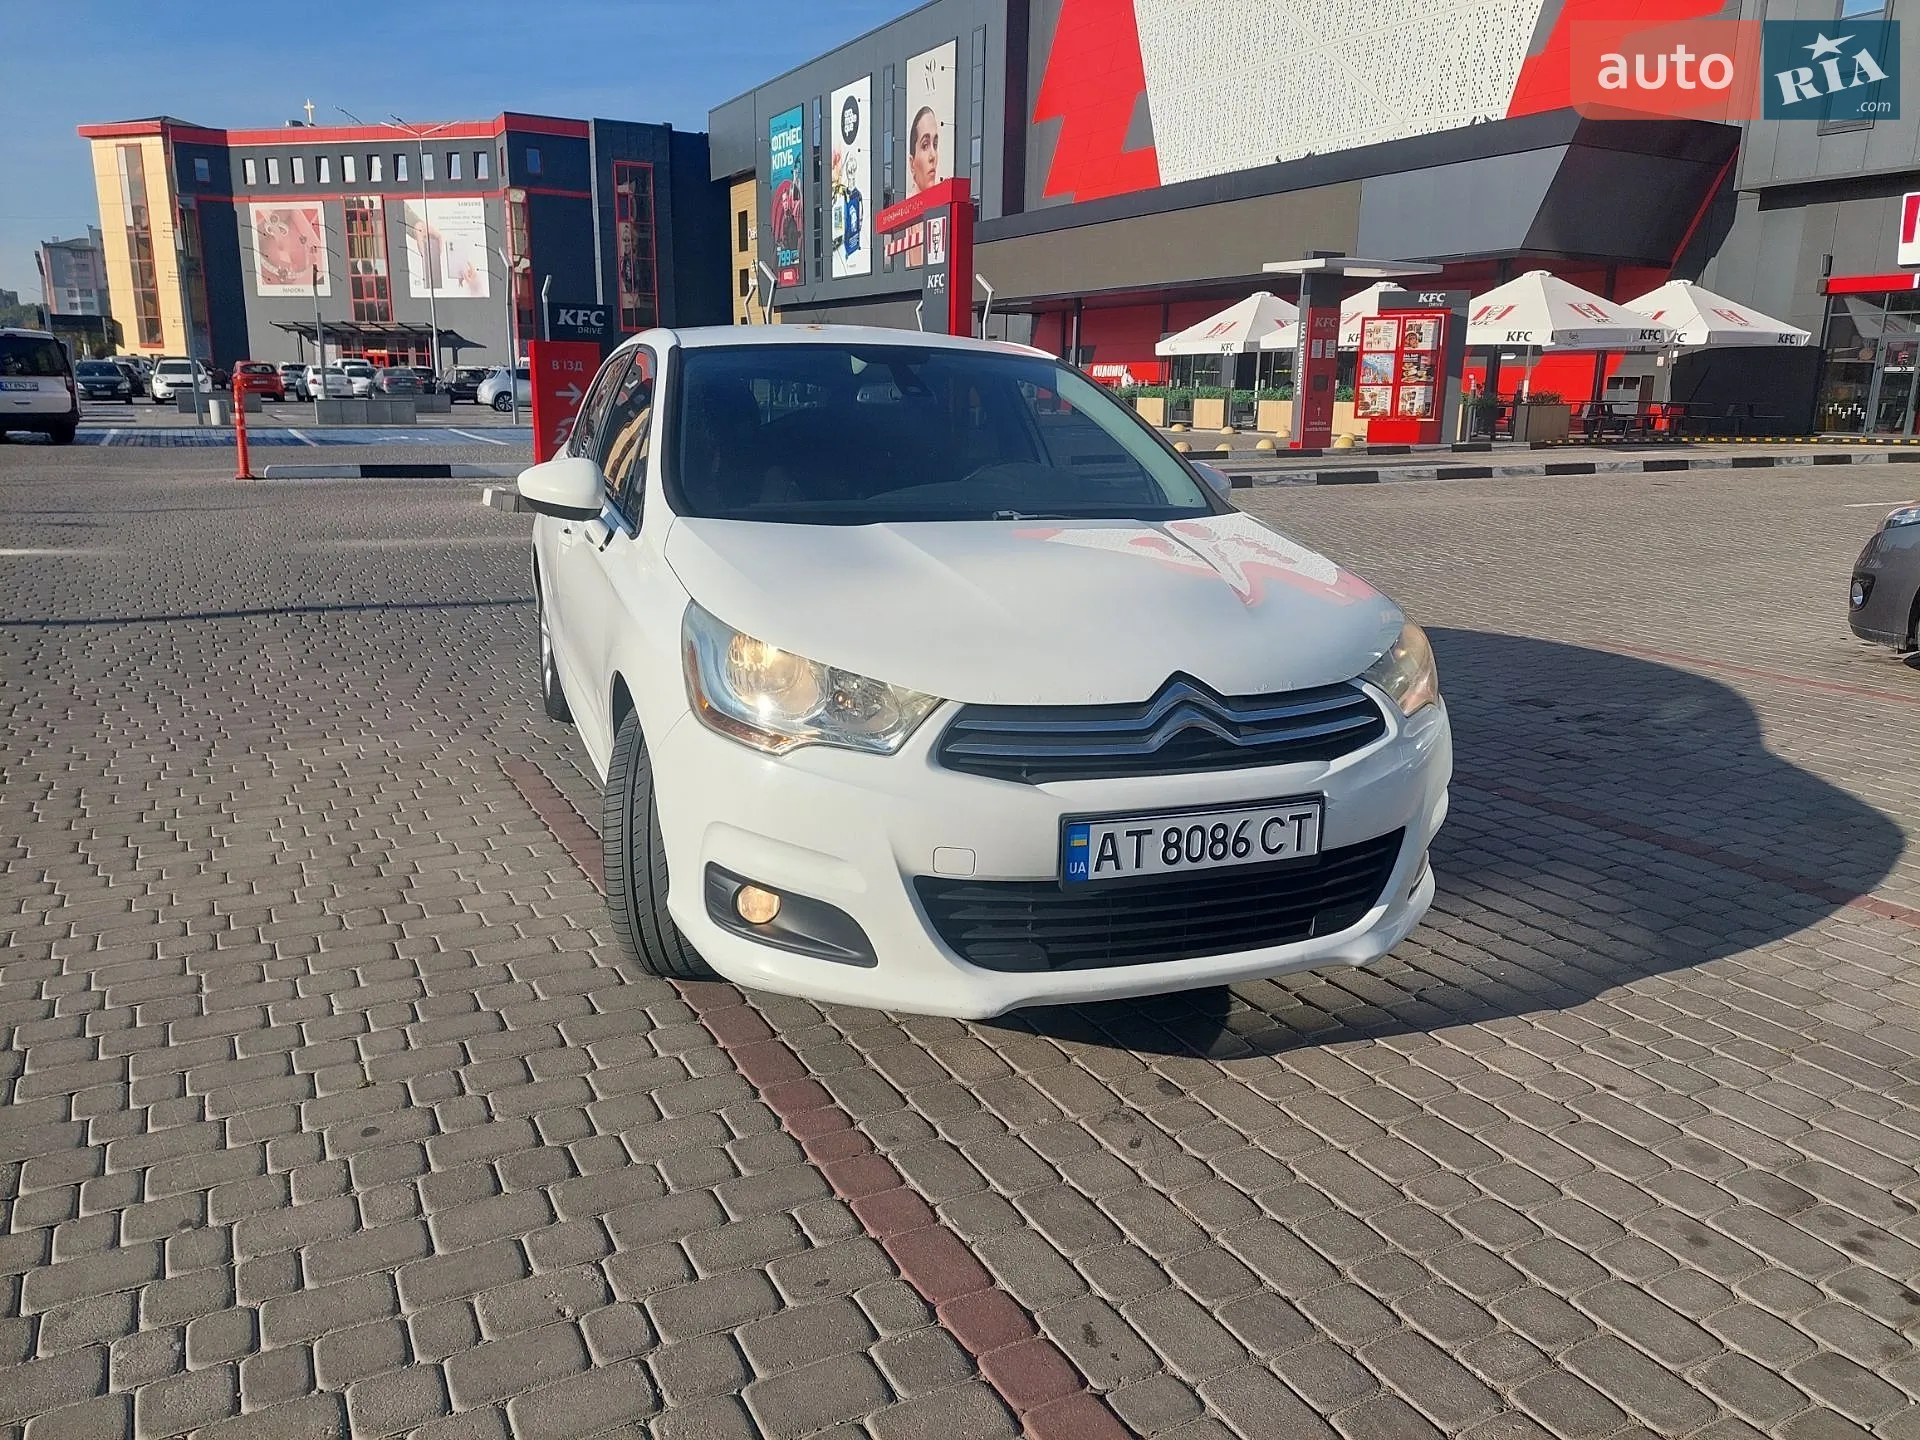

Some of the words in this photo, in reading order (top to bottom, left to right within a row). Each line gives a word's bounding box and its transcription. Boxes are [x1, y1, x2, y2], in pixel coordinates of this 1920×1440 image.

[771, 126, 802, 152] ФІТНЕС
[772, 148, 794, 170] КЛУБ
[927, 273, 945, 289] KFC
[1418, 293, 1446, 303] KFC
[557, 308, 605, 327] KFC
[1314, 317, 1336, 328] KFC
[577, 326, 603, 335] DRIVE
[1505, 331, 1533, 342] KFC
[1639, 329, 1661, 341] KFC
[1347, 333, 1361, 343] KF
[1777, 333, 1796, 344] KFC
[1220, 342, 1235, 352] KFC
[552, 427, 568, 445] 2
[1093, 827, 1153, 873] AT
[1160, 819, 1251, 866] 8086
[1259, 811, 1314, 856] CT
[1069, 861, 1086, 875] UA
